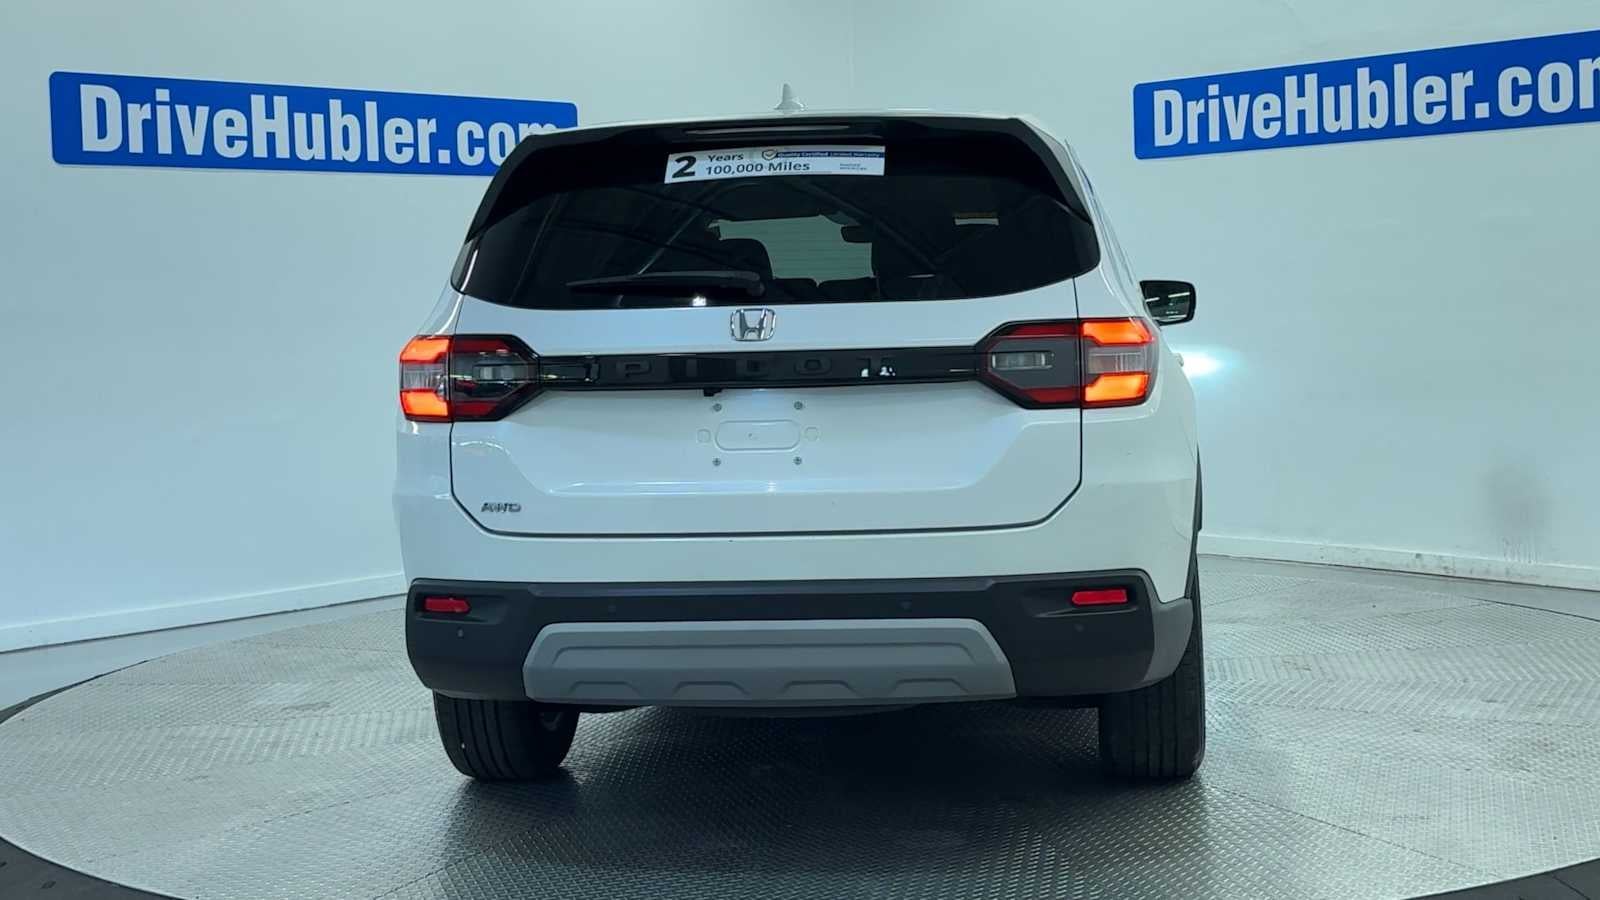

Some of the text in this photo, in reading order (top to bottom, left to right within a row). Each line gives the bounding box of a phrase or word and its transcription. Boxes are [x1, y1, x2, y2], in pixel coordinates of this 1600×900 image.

[79, 83, 560, 167] DriveHubler.co
[707, 153, 744, 162] Years
[672, 155, 697, 178] 2
[706, 161, 811, 175] 100,000 Miles
[481, 502, 522, 513] AWD
